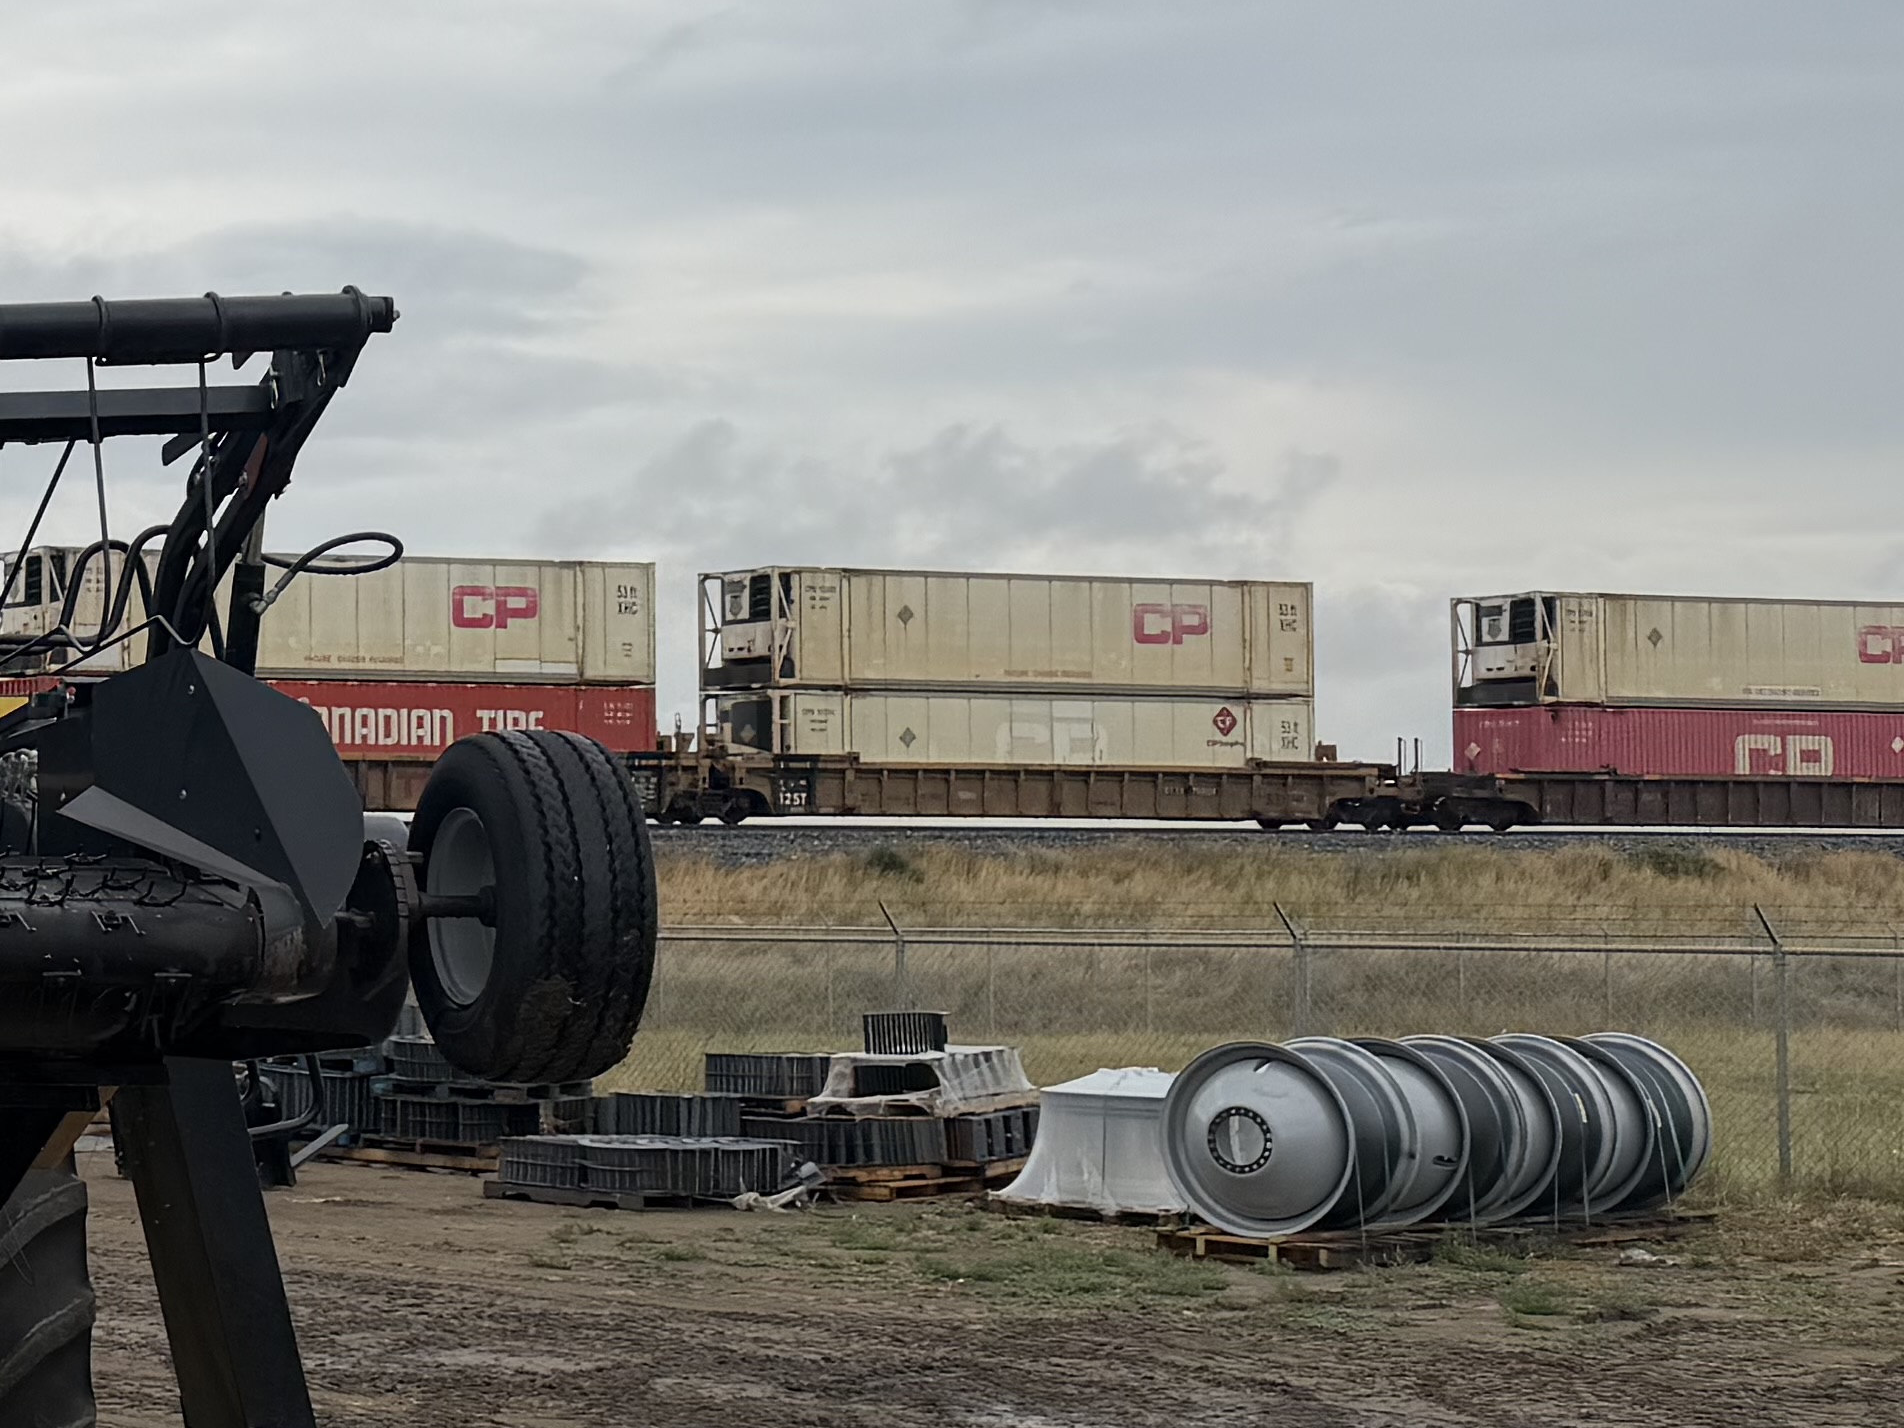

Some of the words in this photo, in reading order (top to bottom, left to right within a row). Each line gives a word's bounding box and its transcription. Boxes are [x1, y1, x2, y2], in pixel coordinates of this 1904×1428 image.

[452, 585, 538, 629] CP
[1134, 603, 1209, 645] CP
[779, 793, 807, 805] 125T
